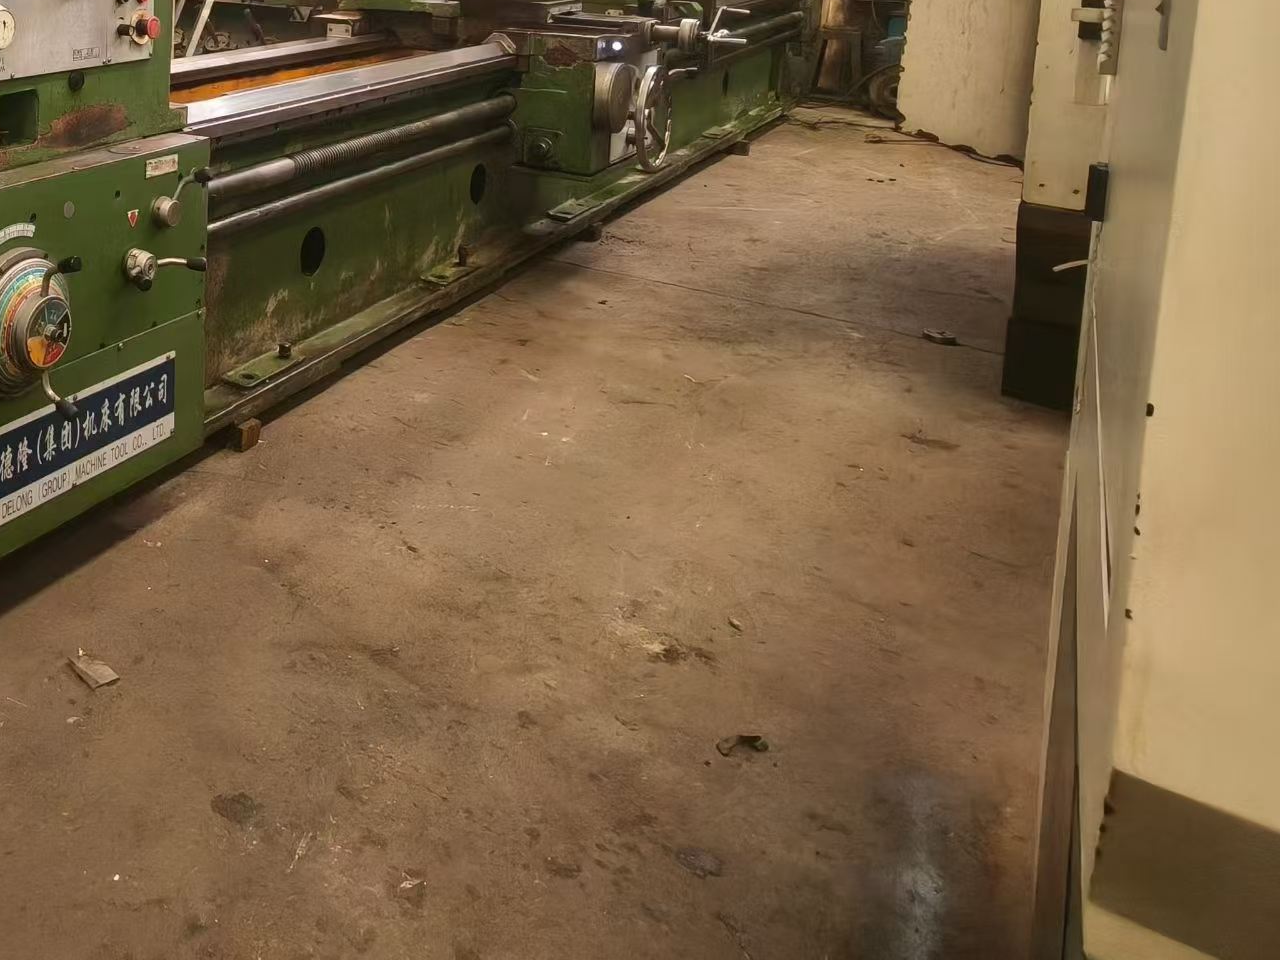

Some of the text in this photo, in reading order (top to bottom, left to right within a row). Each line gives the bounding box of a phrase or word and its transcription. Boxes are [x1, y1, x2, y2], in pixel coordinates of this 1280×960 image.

[1, 489, 33, 519] DELONG
[38, 470, 70, 501] (GROUP)
[75, 451, 107, 478] MACHINE
[111, 442, 129, 461] TOOL
